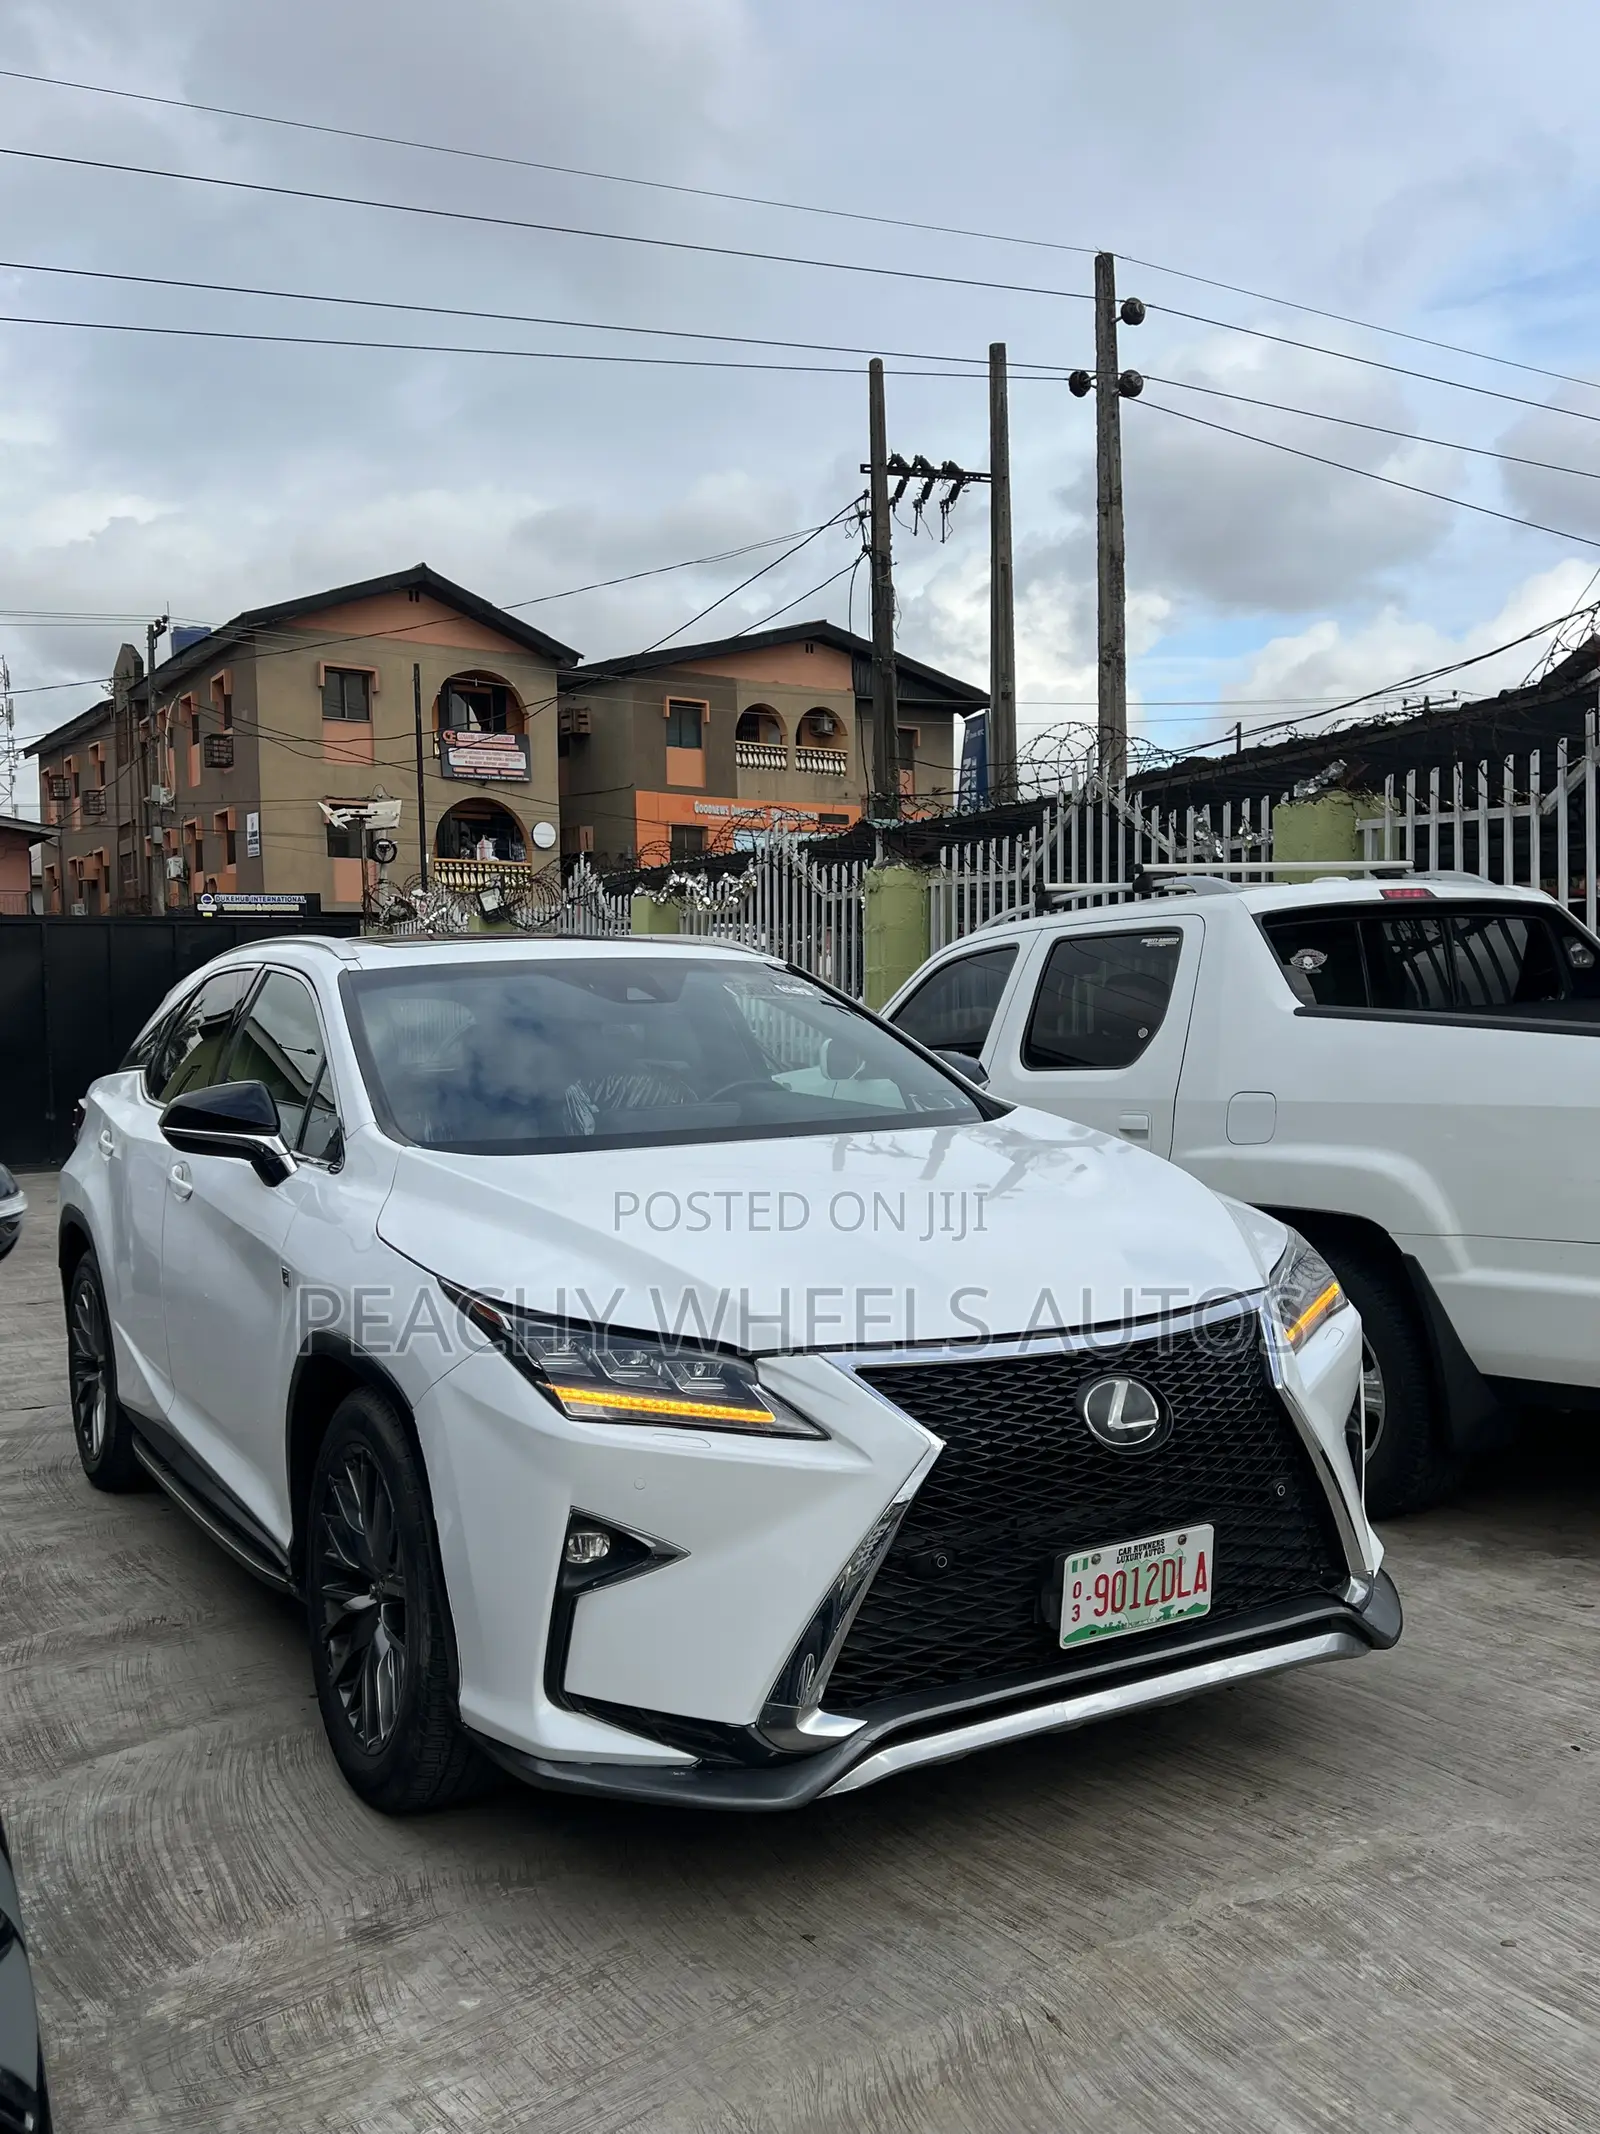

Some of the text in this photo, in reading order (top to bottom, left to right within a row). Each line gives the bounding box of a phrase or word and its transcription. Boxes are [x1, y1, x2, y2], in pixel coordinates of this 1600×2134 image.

[214, 894, 307, 903] DUKEHUB INTERNATIONAL
[1116, 1546, 1166, 1564] LUXURY AUTOS
[1118, 1539, 1165, 1556] CAR RUNNERS
